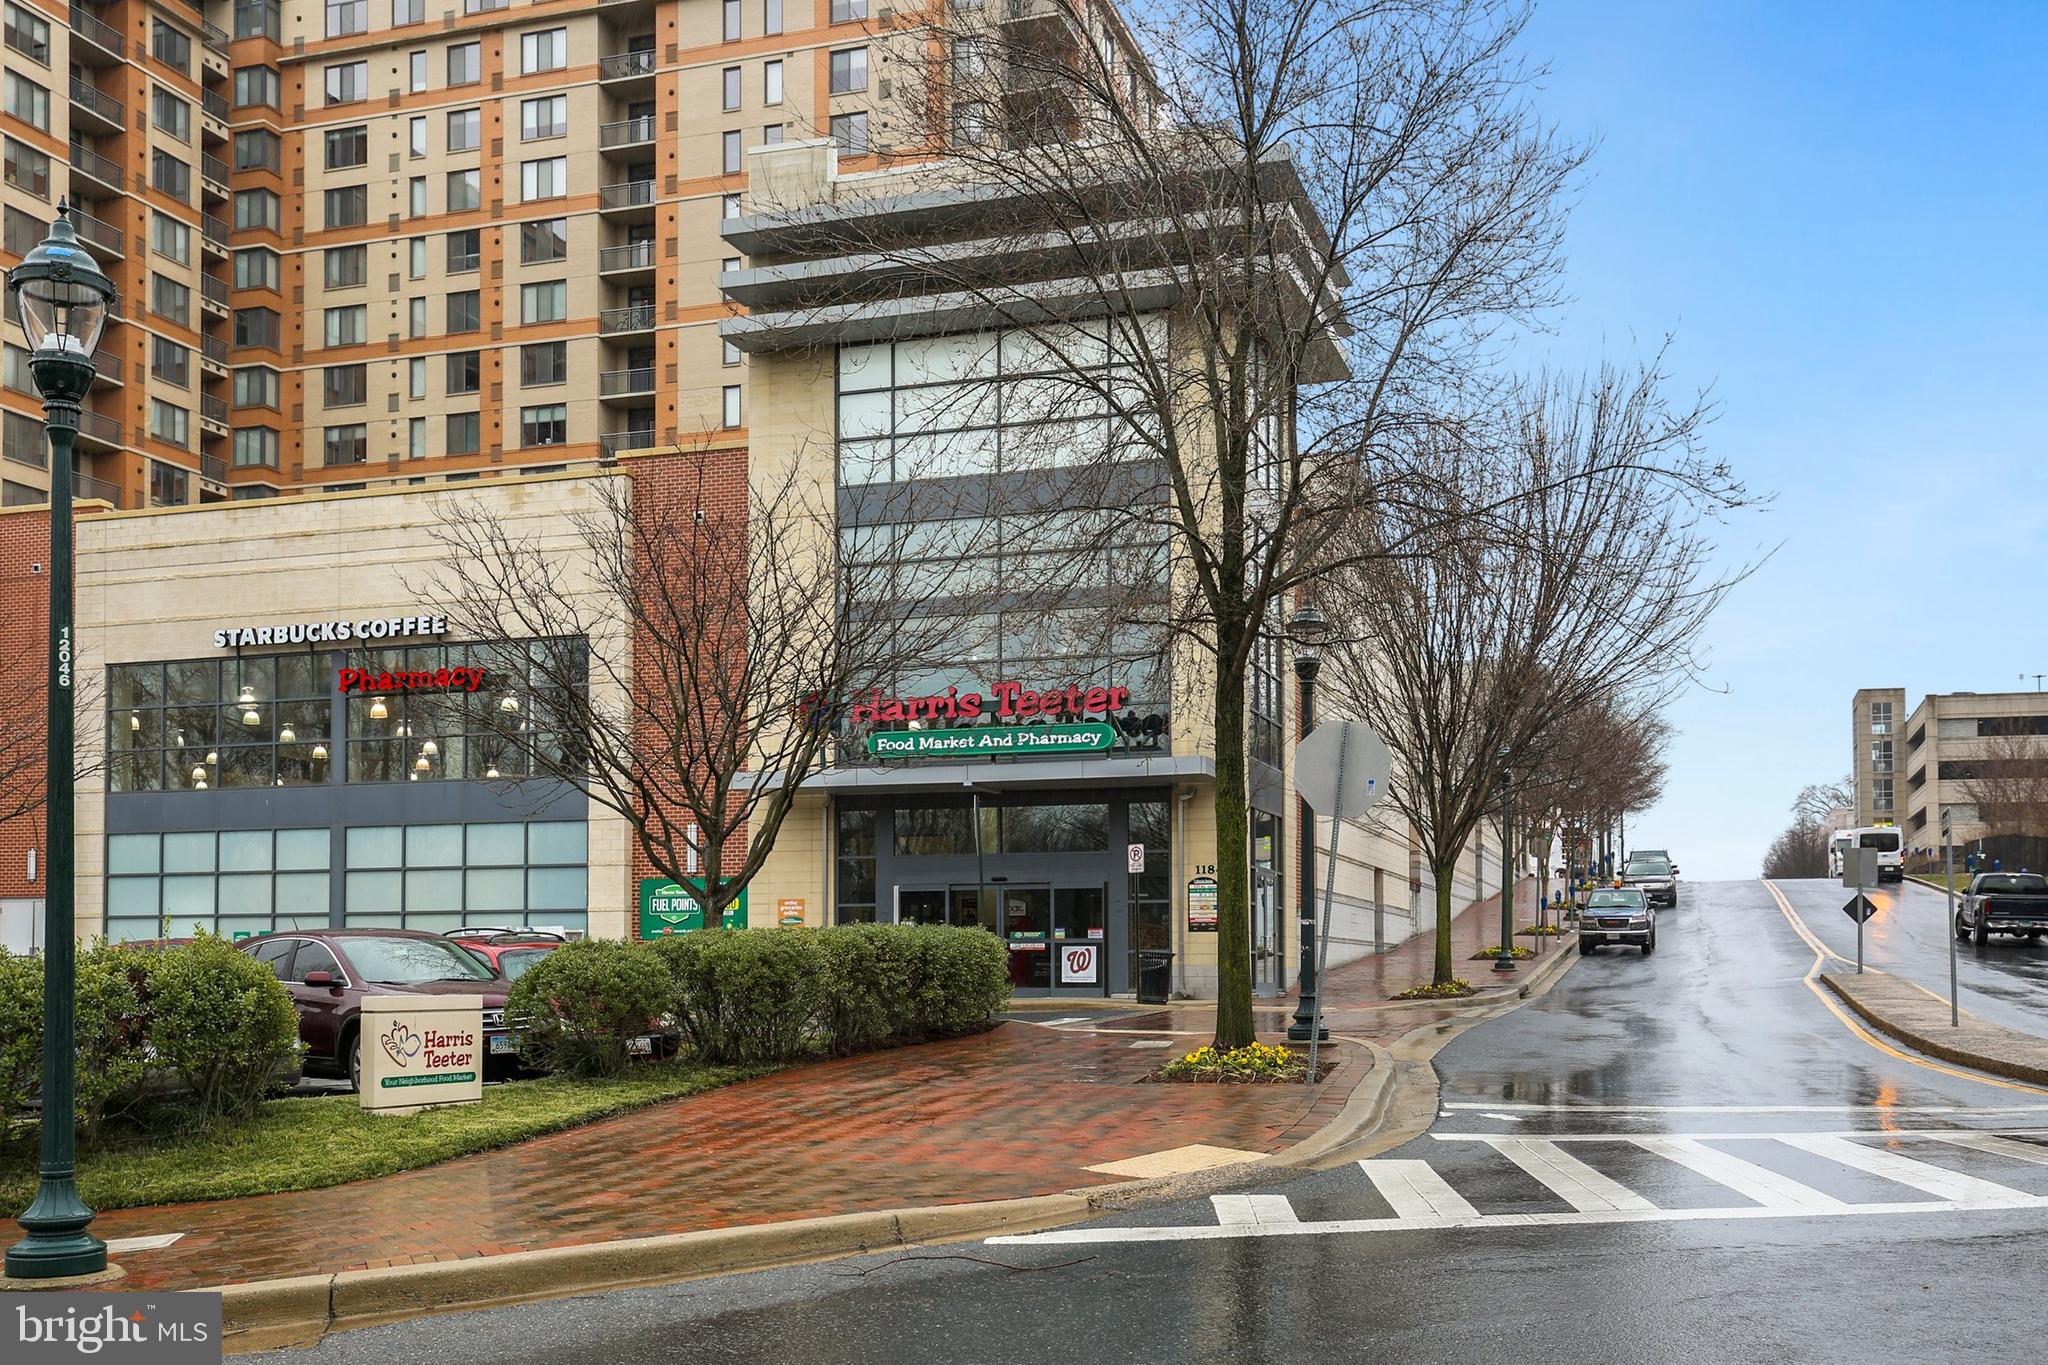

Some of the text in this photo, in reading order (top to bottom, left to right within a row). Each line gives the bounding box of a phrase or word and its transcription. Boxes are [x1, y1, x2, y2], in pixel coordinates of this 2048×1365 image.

[213, 615, 449, 649] STARBUCKS COFFEE
[58, 626, 71, 687] 12046
[338, 666, 486, 692] Pharmacy
[849, 680, 1129, 723] Harris Teeter
[877, 732, 1102, 751] Food Market And Pharmacy
[652, 897, 698, 912] FUEL POINTS
[424, 1030, 473, 1049] Harris
[424, 1050, 472, 1068] Teeter
[384, 1078, 398, 1086] Your
[398, 1076, 438, 1086] Neighborhood
[453, 1073, 473, 1081] Market
